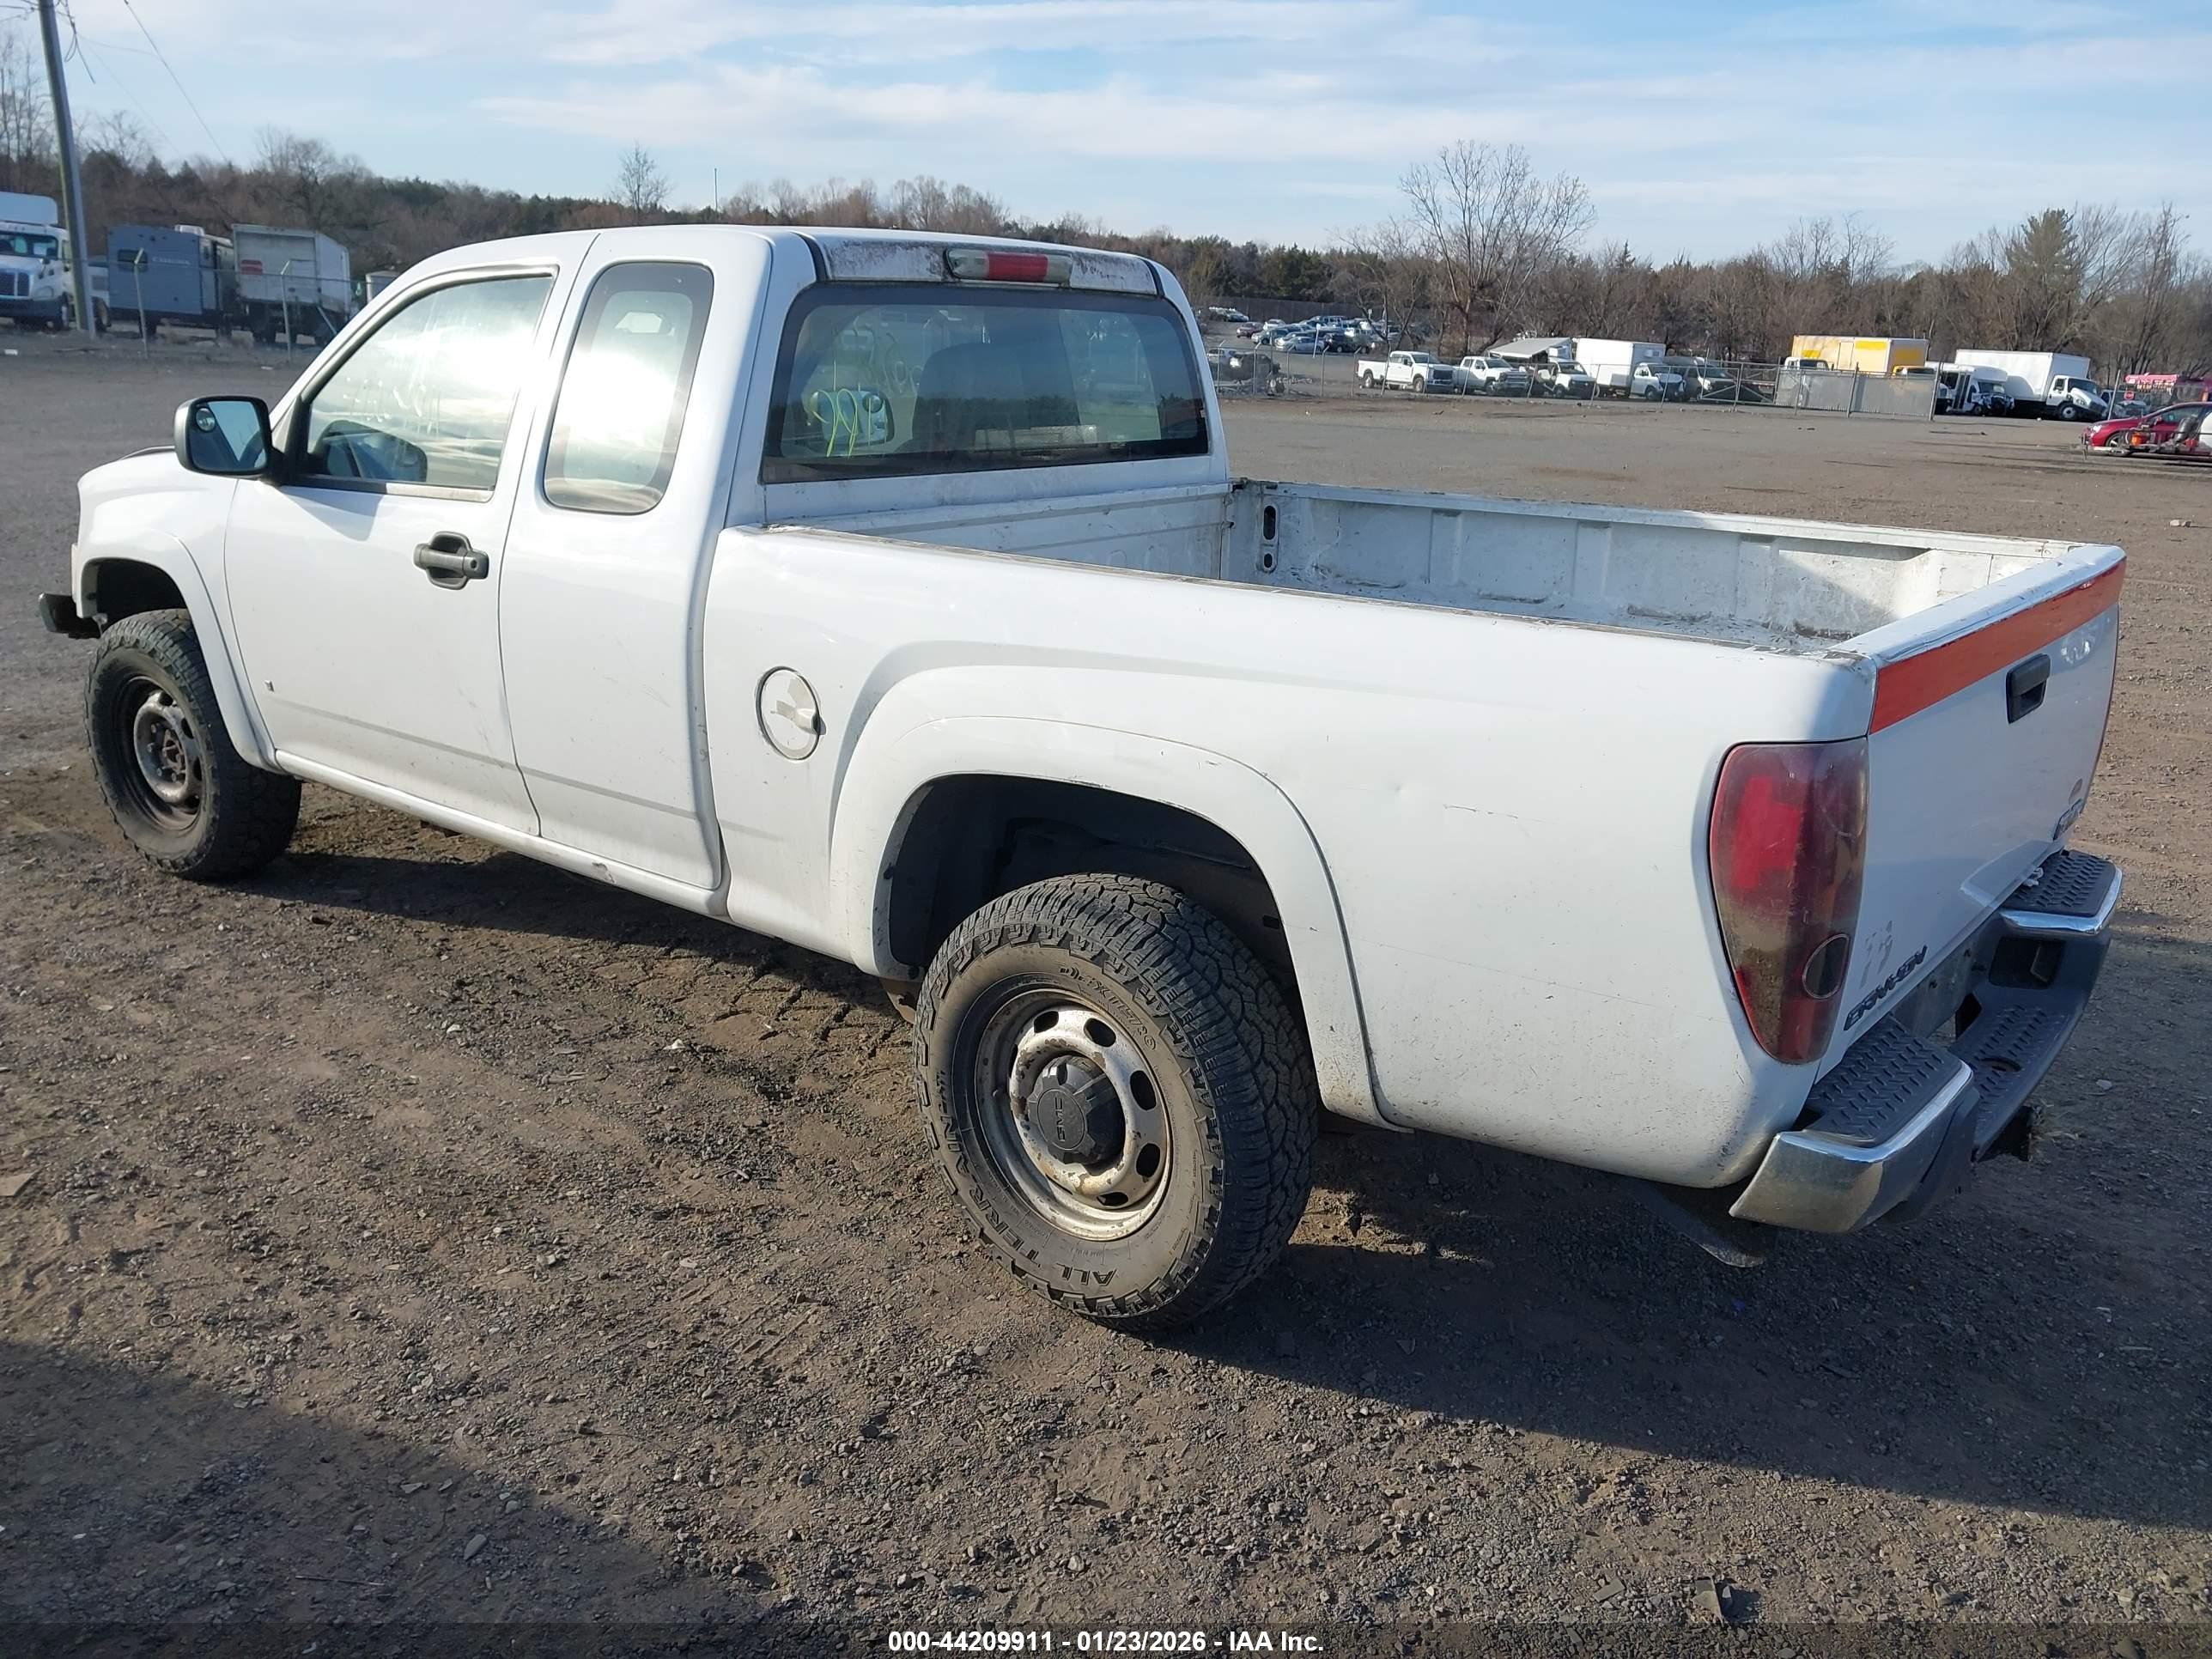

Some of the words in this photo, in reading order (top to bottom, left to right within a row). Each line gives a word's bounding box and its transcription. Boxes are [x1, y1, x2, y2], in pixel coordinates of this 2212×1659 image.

[1054, 1097, 1066, 1143] GMC
[939, 1114, 1042, 1267] TERRAIN
[1056, 1262, 1117, 1286] ALL
